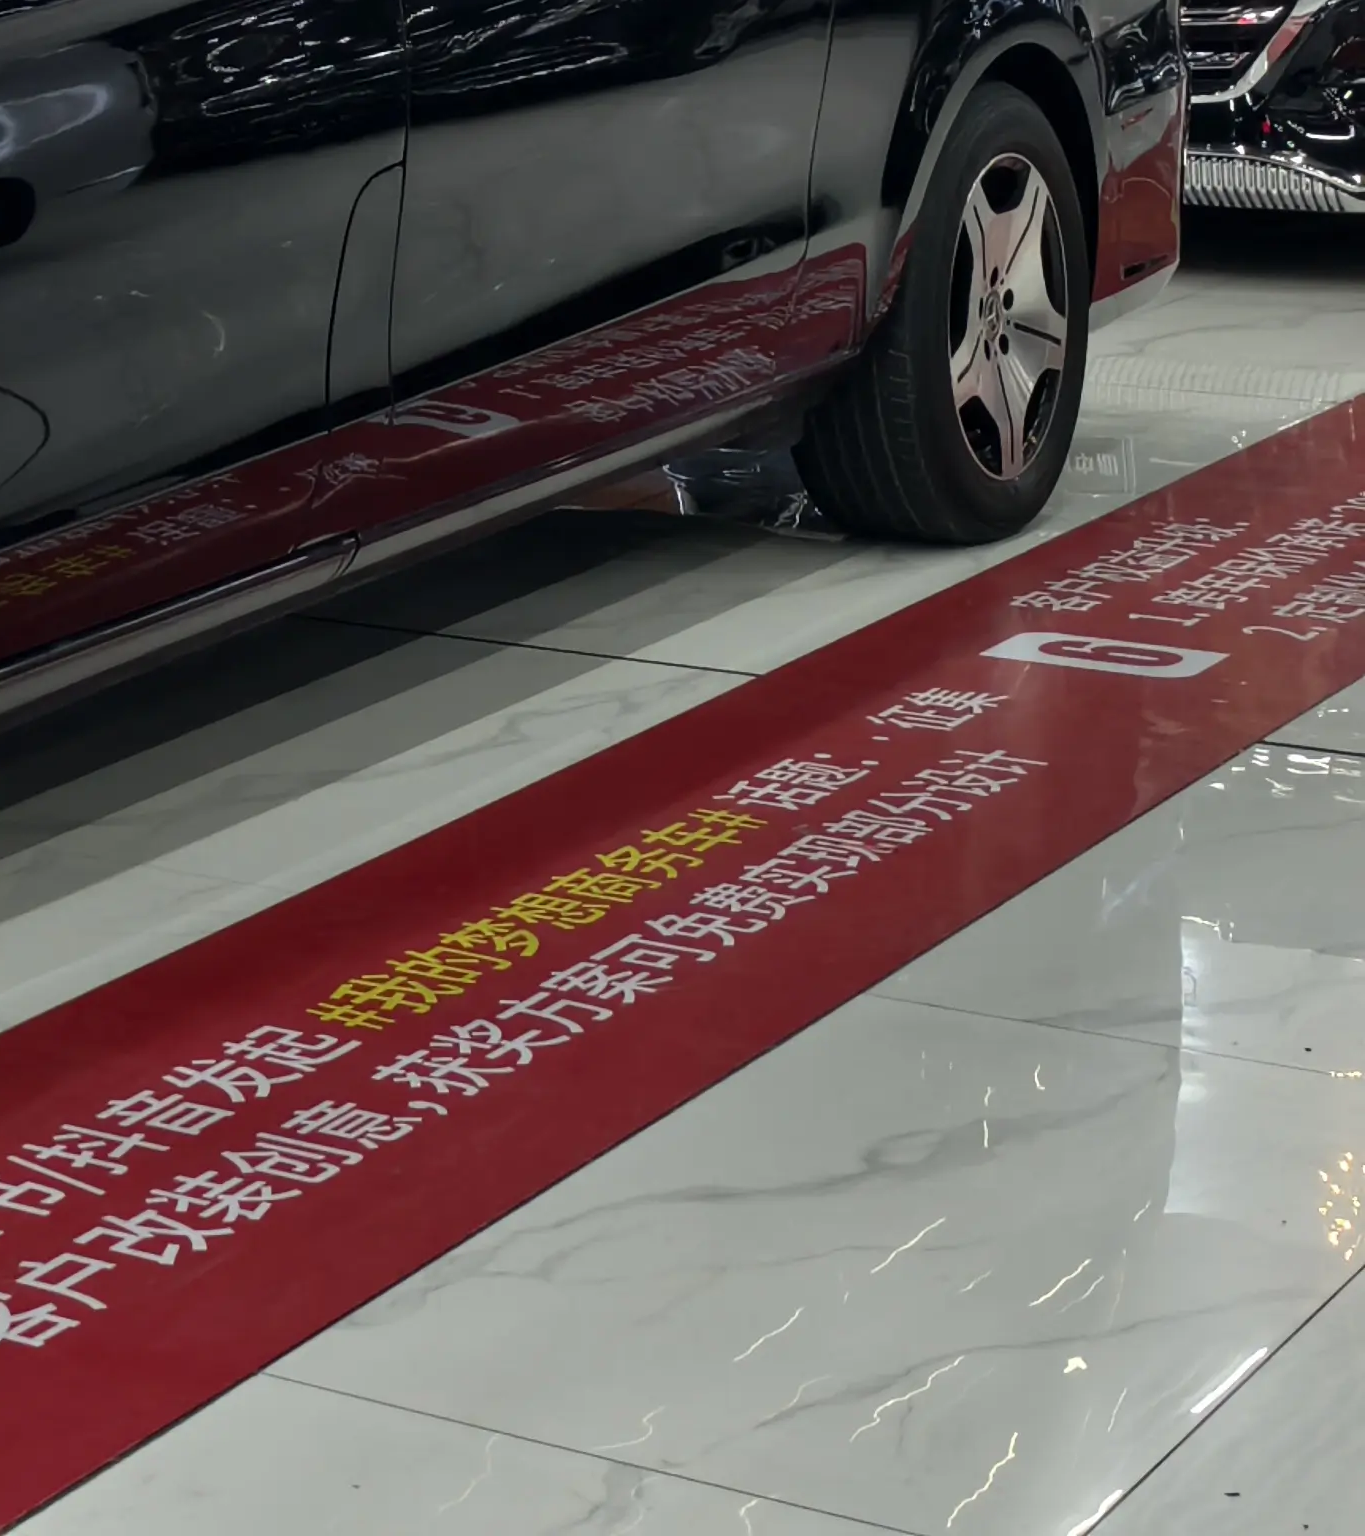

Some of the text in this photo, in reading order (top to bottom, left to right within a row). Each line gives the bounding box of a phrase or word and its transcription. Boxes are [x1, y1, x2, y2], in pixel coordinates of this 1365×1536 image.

[304, 807, 770, 1032] #我的梦想商务车#
